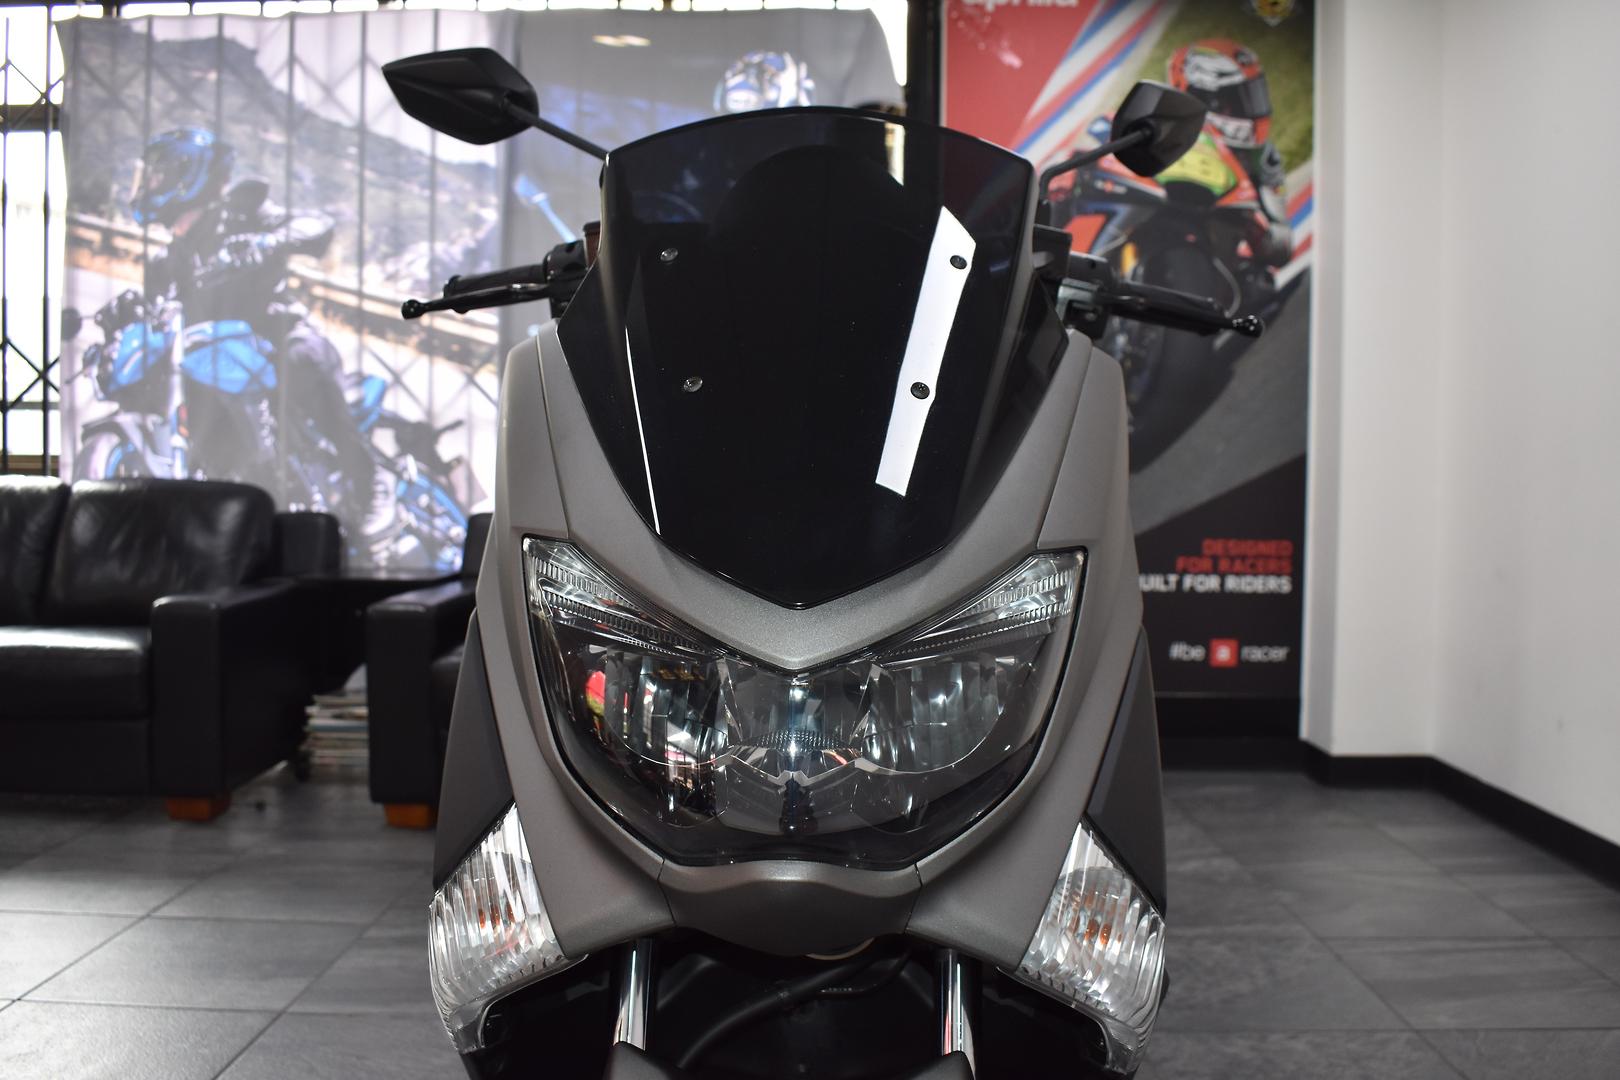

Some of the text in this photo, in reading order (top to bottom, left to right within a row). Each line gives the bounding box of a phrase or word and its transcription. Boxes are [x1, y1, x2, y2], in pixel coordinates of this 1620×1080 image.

[1202, 539, 1293, 556] DESIGNED
[1176, 556, 1292, 574] FOR RACERS
[1138, 573, 1293, 594] UILT FOR RIDERS
[1169, 640, 1205, 661] #be
[1241, 645, 1289, 662] racer
